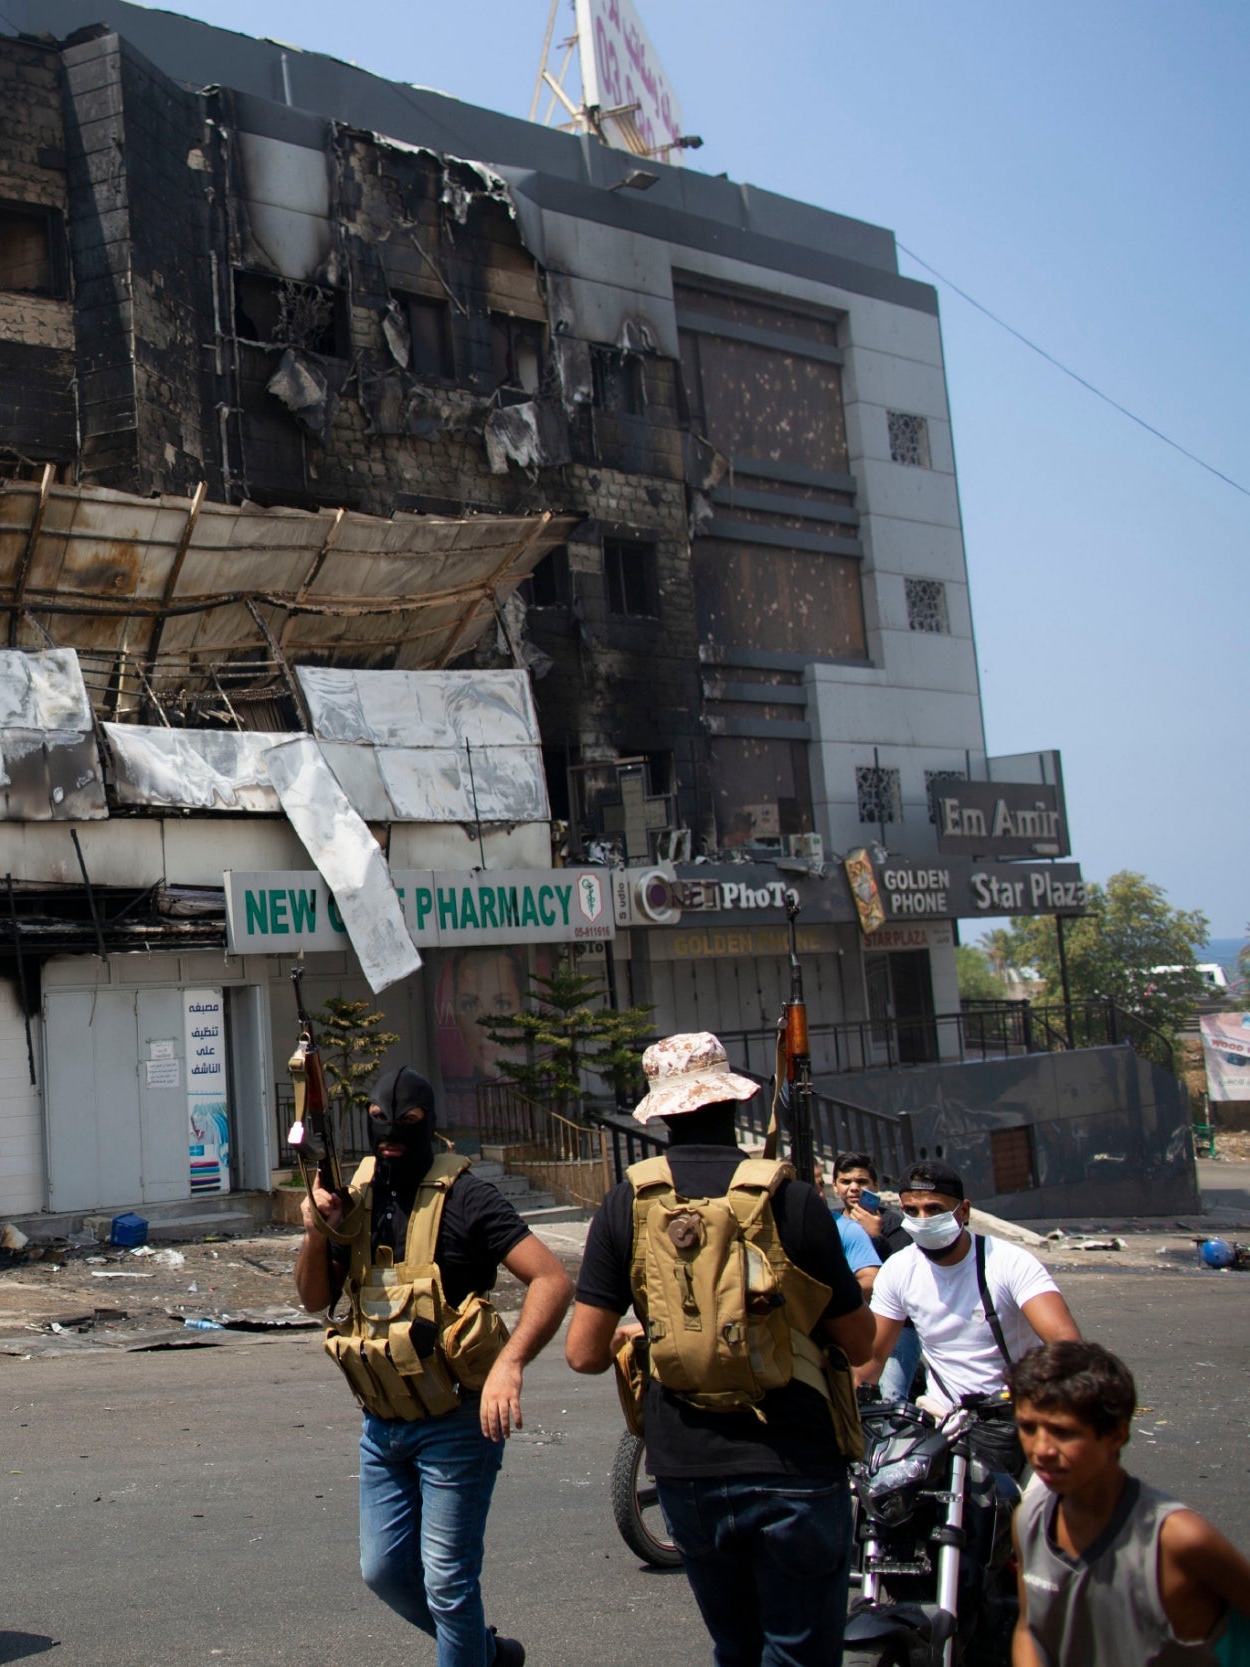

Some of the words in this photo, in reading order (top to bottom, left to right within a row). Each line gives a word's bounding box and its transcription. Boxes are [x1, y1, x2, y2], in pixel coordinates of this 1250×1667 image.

[941, 798, 987, 837] Em
[992, 799, 1060, 837] Amir
[884, 870, 950, 890] GOLDEN
[972, 872, 1024, 909] Star
[1030, 871, 1088, 907] Plaza
[245, 889, 316, 935] NEW
[415, 885, 573, 930] PHARMACY
[891, 892, 947, 913] PHONE
[674, 932, 752, 955] GOLDEN
[191, 1026, 219, 1040] تنظيف
[1211, 1038, 1244, 1052] WOOD
[191, 1062, 221, 1075] الناشف
